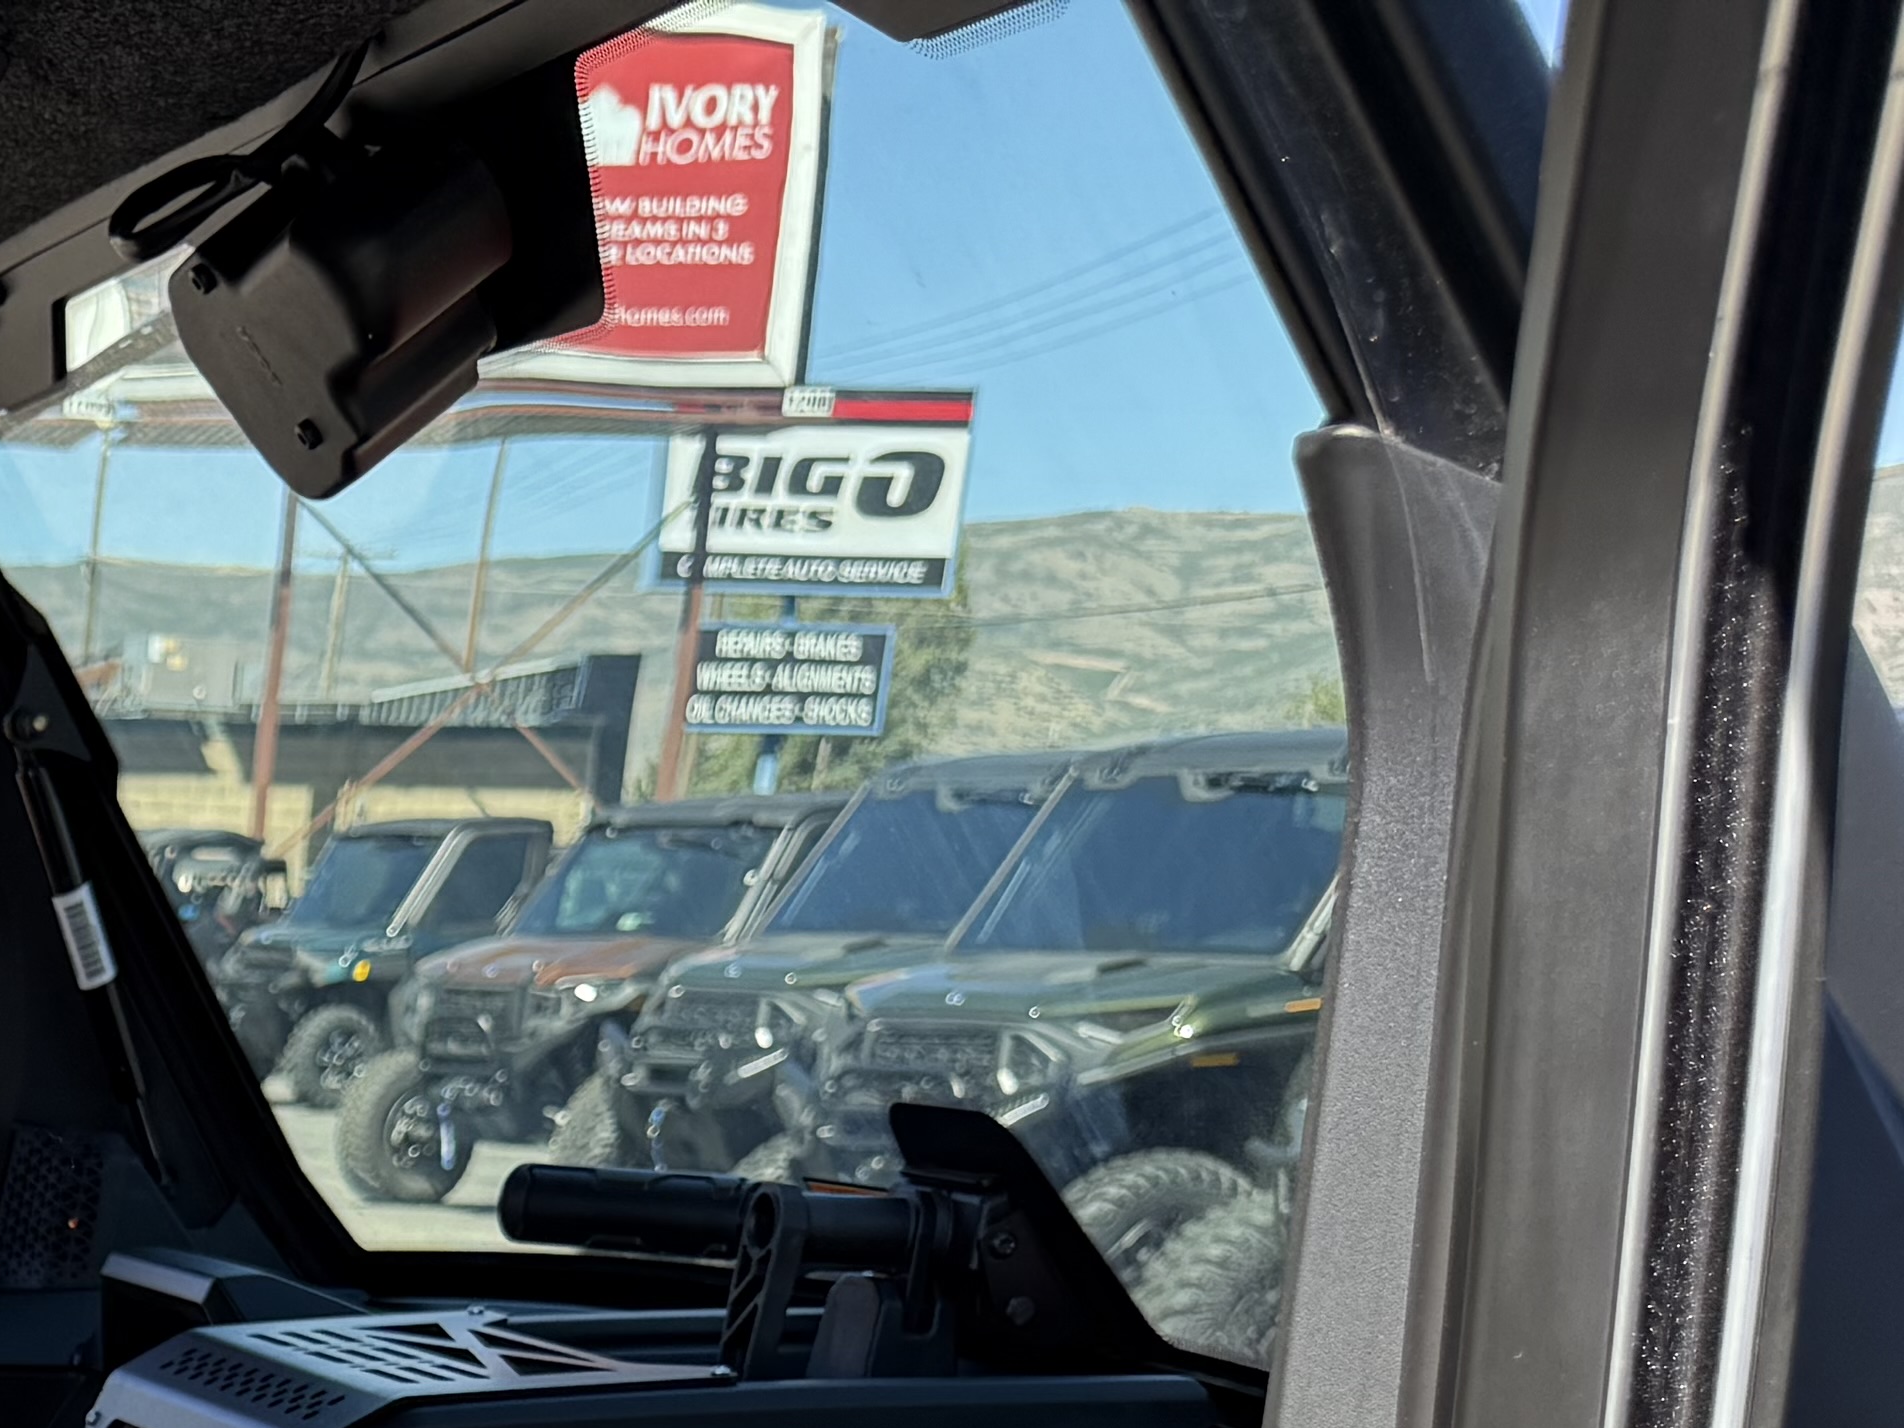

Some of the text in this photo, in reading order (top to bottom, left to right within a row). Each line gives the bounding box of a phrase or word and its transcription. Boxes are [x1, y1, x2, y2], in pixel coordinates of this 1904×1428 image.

[647, 84, 778, 130] IVORY
[639, 128, 774, 165] HOMES
[638, 193, 749, 218] BUILDING
[683, 218, 708, 241] IN
[625, 241, 755, 266] LOCATIONS
[692, 455, 850, 496] BIG
[677, 554, 928, 584] CMPLETE AUTO SERVICE
[793, 630, 863, 661] BRAKES
[772, 662, 876, 694] ALIGNMENTS
[685, 693, 873, 727] OIL CHANGES SHOCKS
